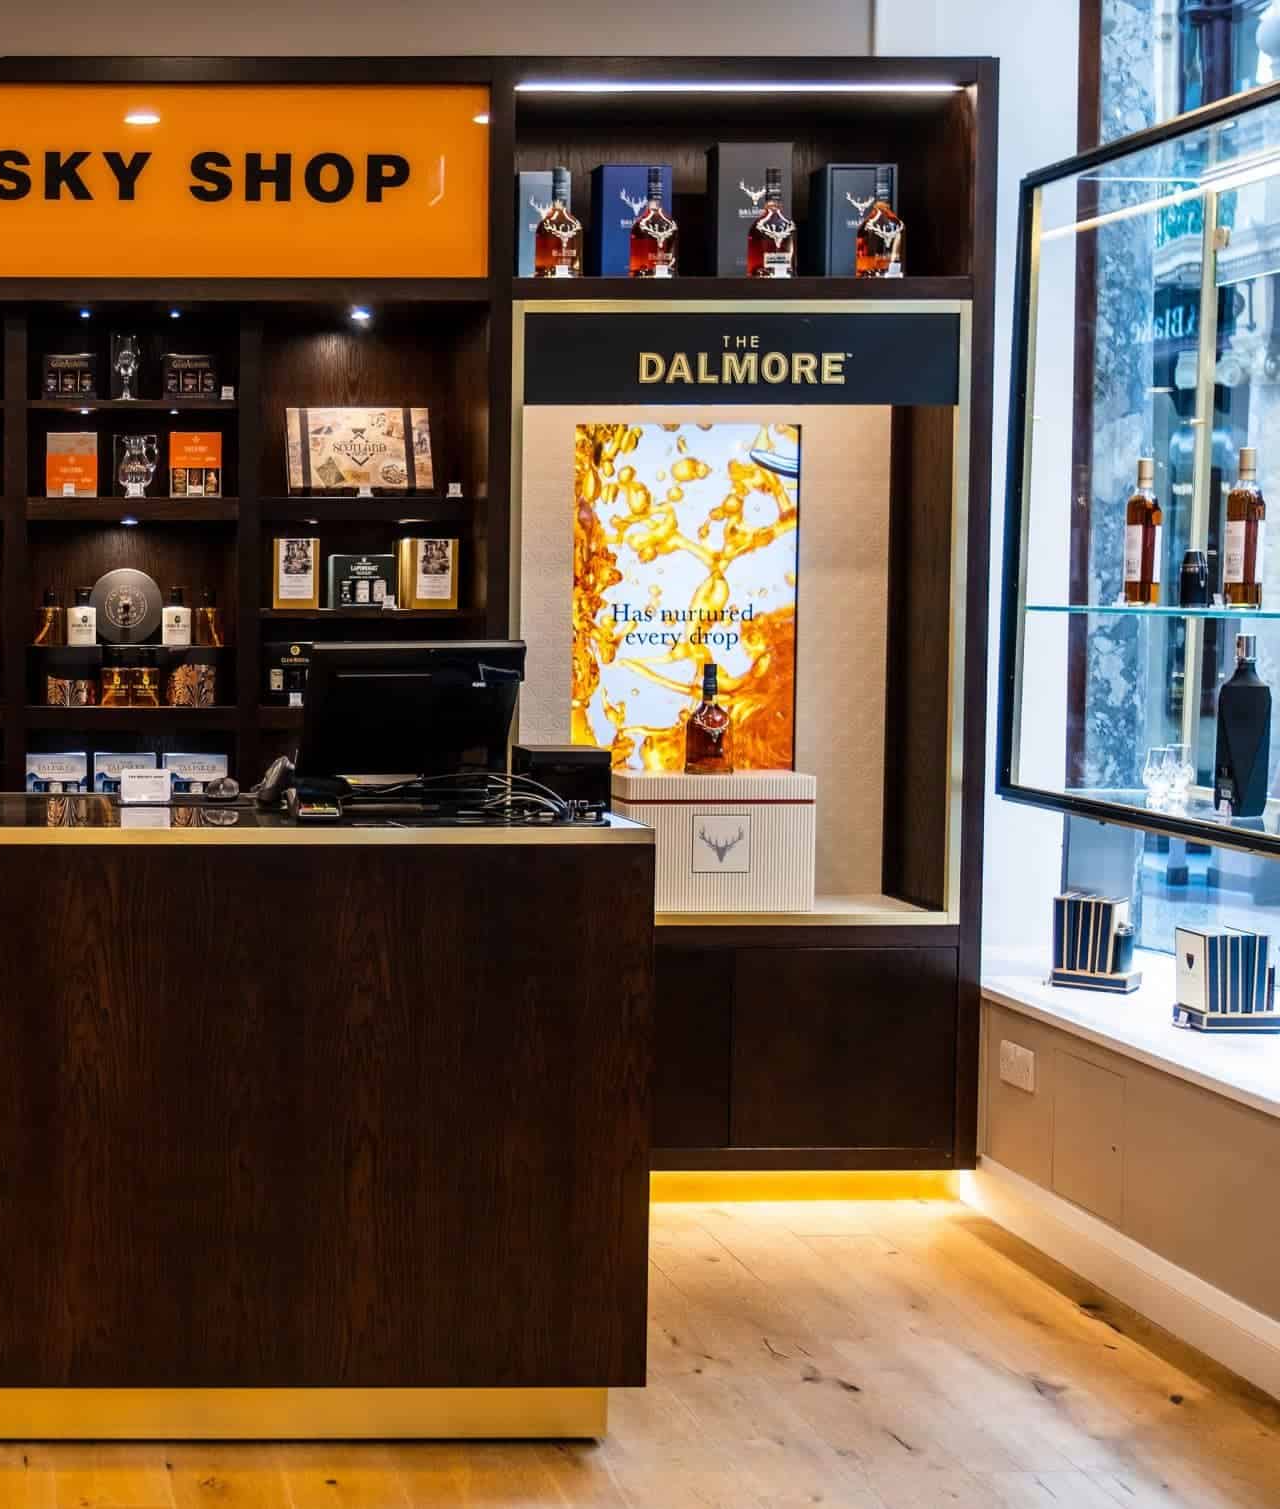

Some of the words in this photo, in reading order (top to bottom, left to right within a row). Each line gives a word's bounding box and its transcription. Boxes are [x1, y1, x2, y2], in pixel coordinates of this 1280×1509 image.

[188, 151, 411, 204] SHOP
[723, 335, 760, 349] THE
[638, 352, 846, 384] DALMORE
[612, 604, 653, 623] Has
[661, 604, 754, 623] nurtured
[625, 631, 682, 650] every
[689, 628, 739, 650] drop
